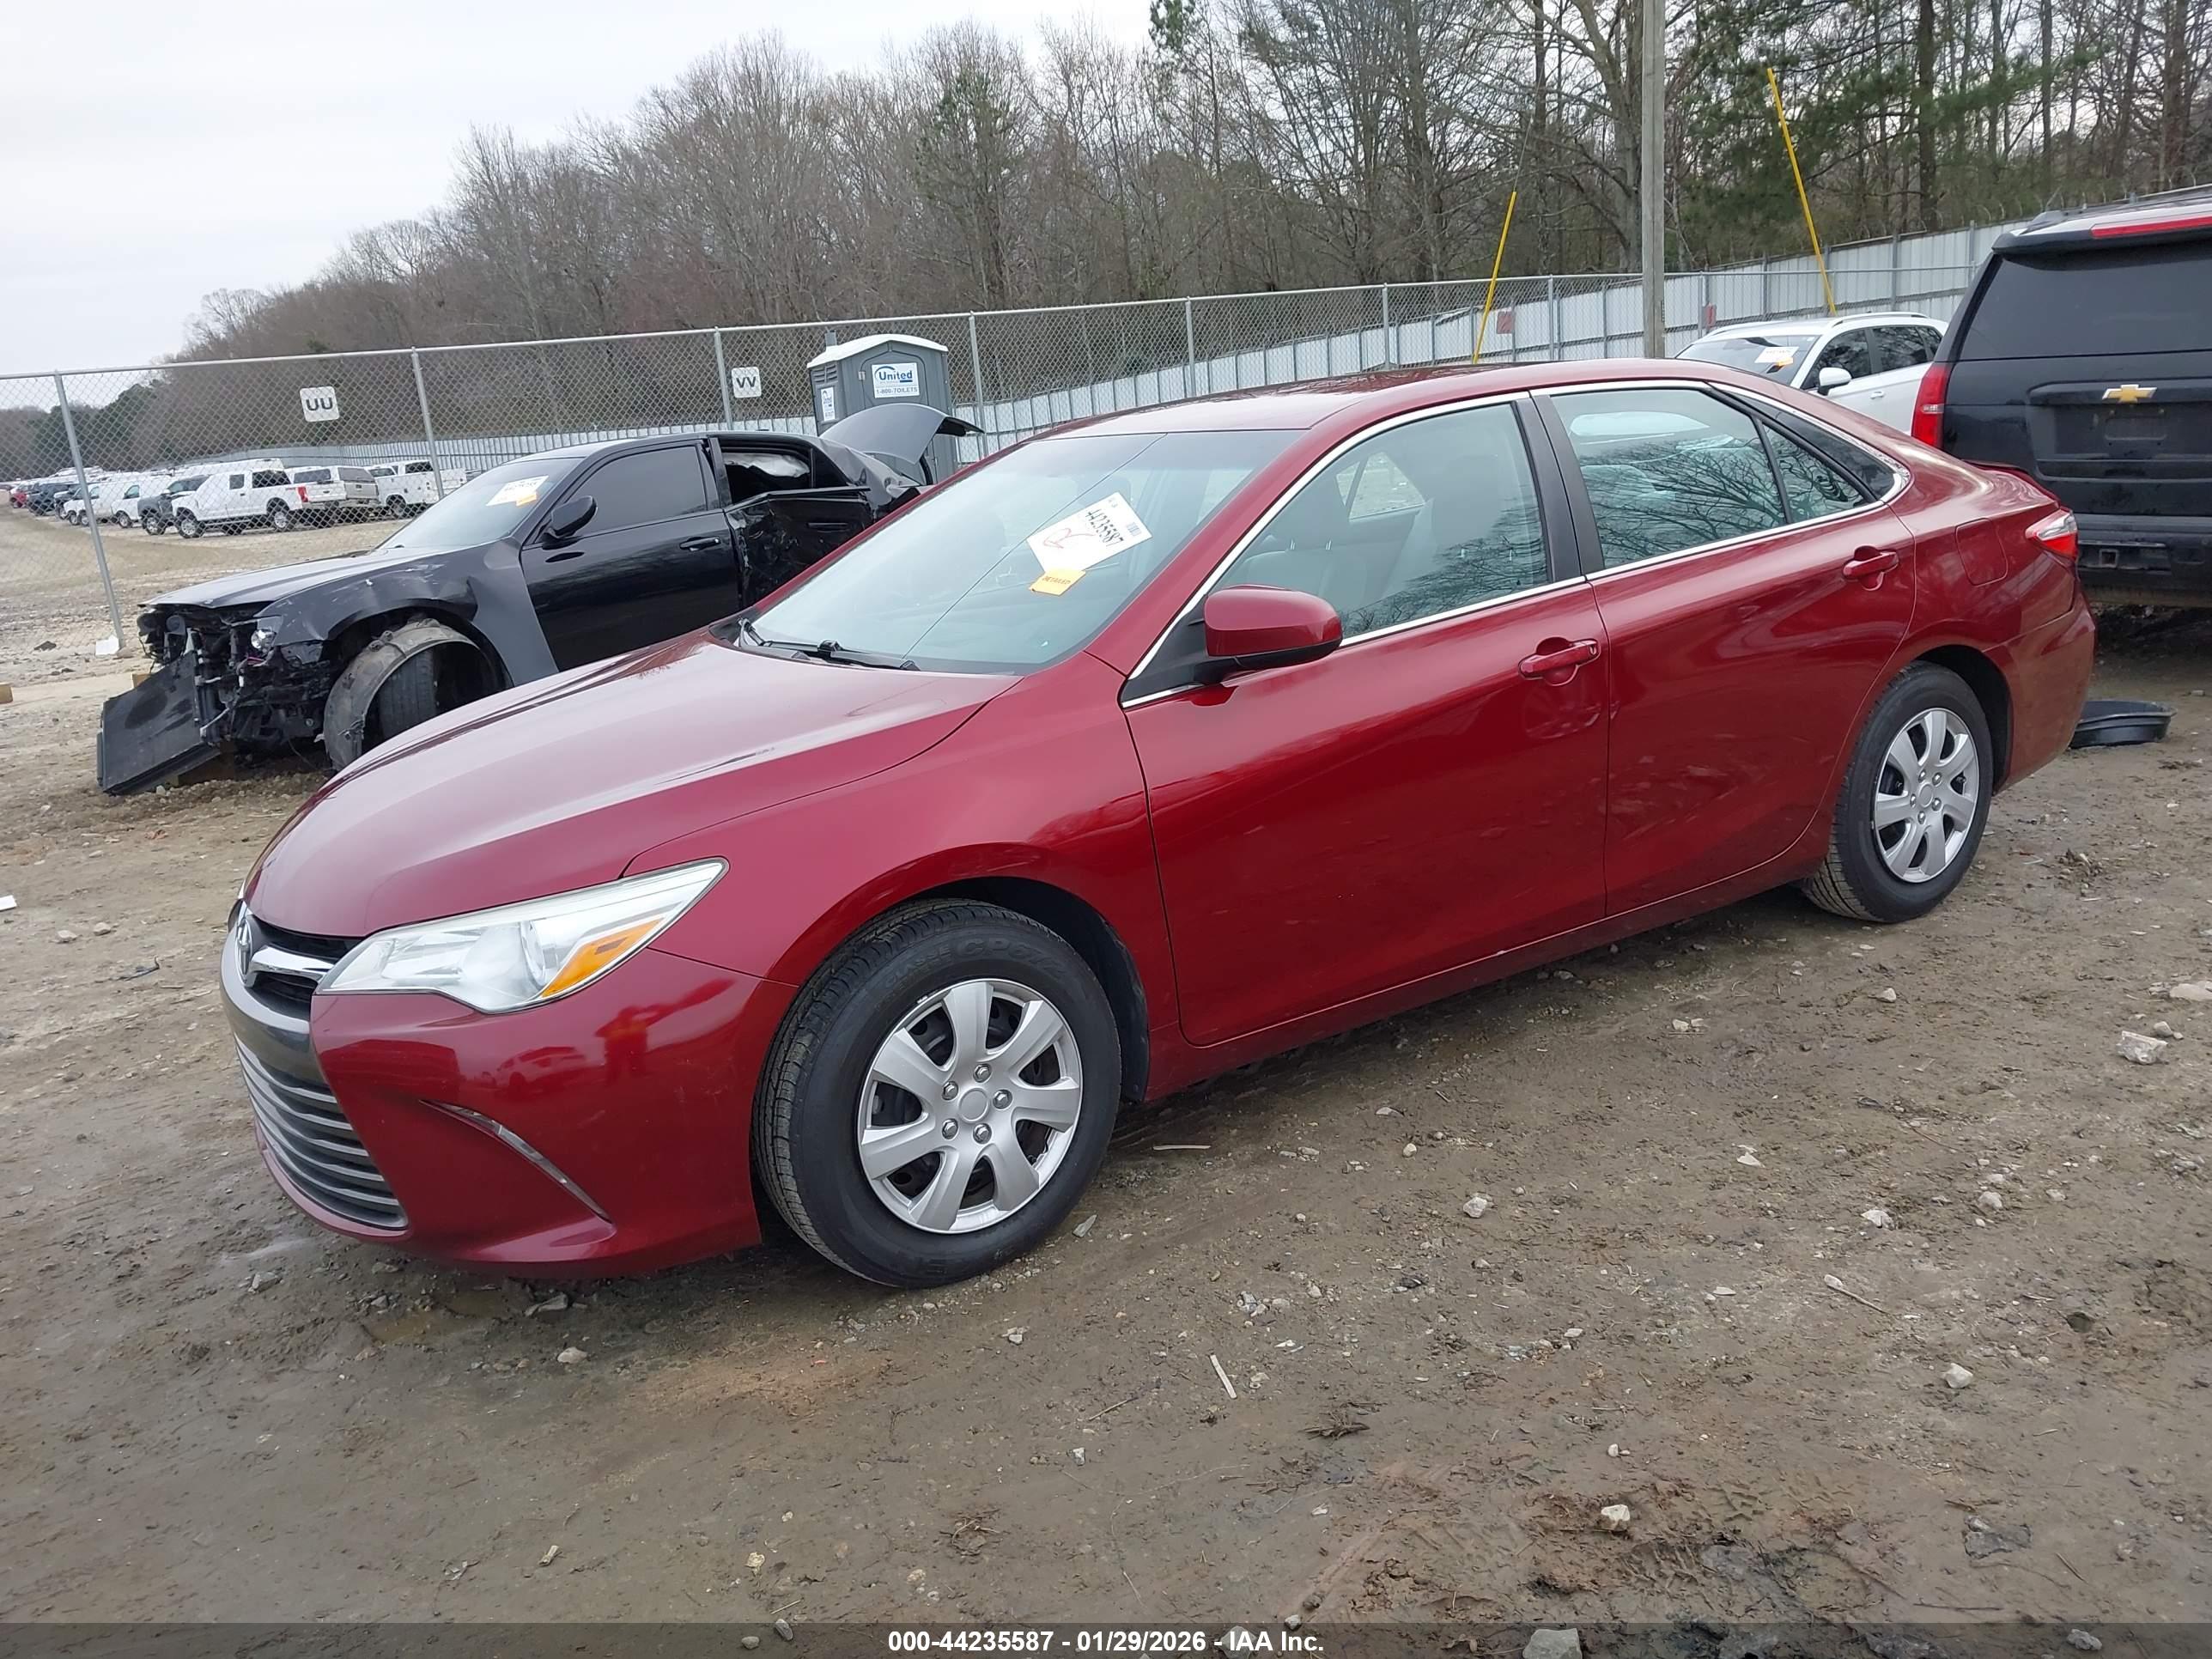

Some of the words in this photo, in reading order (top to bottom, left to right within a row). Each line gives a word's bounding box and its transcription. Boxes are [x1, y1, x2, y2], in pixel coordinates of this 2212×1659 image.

[878, 370, 913, 380] United
[736, 376, 756, 388] VV
[306, 397, 333, 410] UU
[1085, 509, 1124, 547] 44235587
